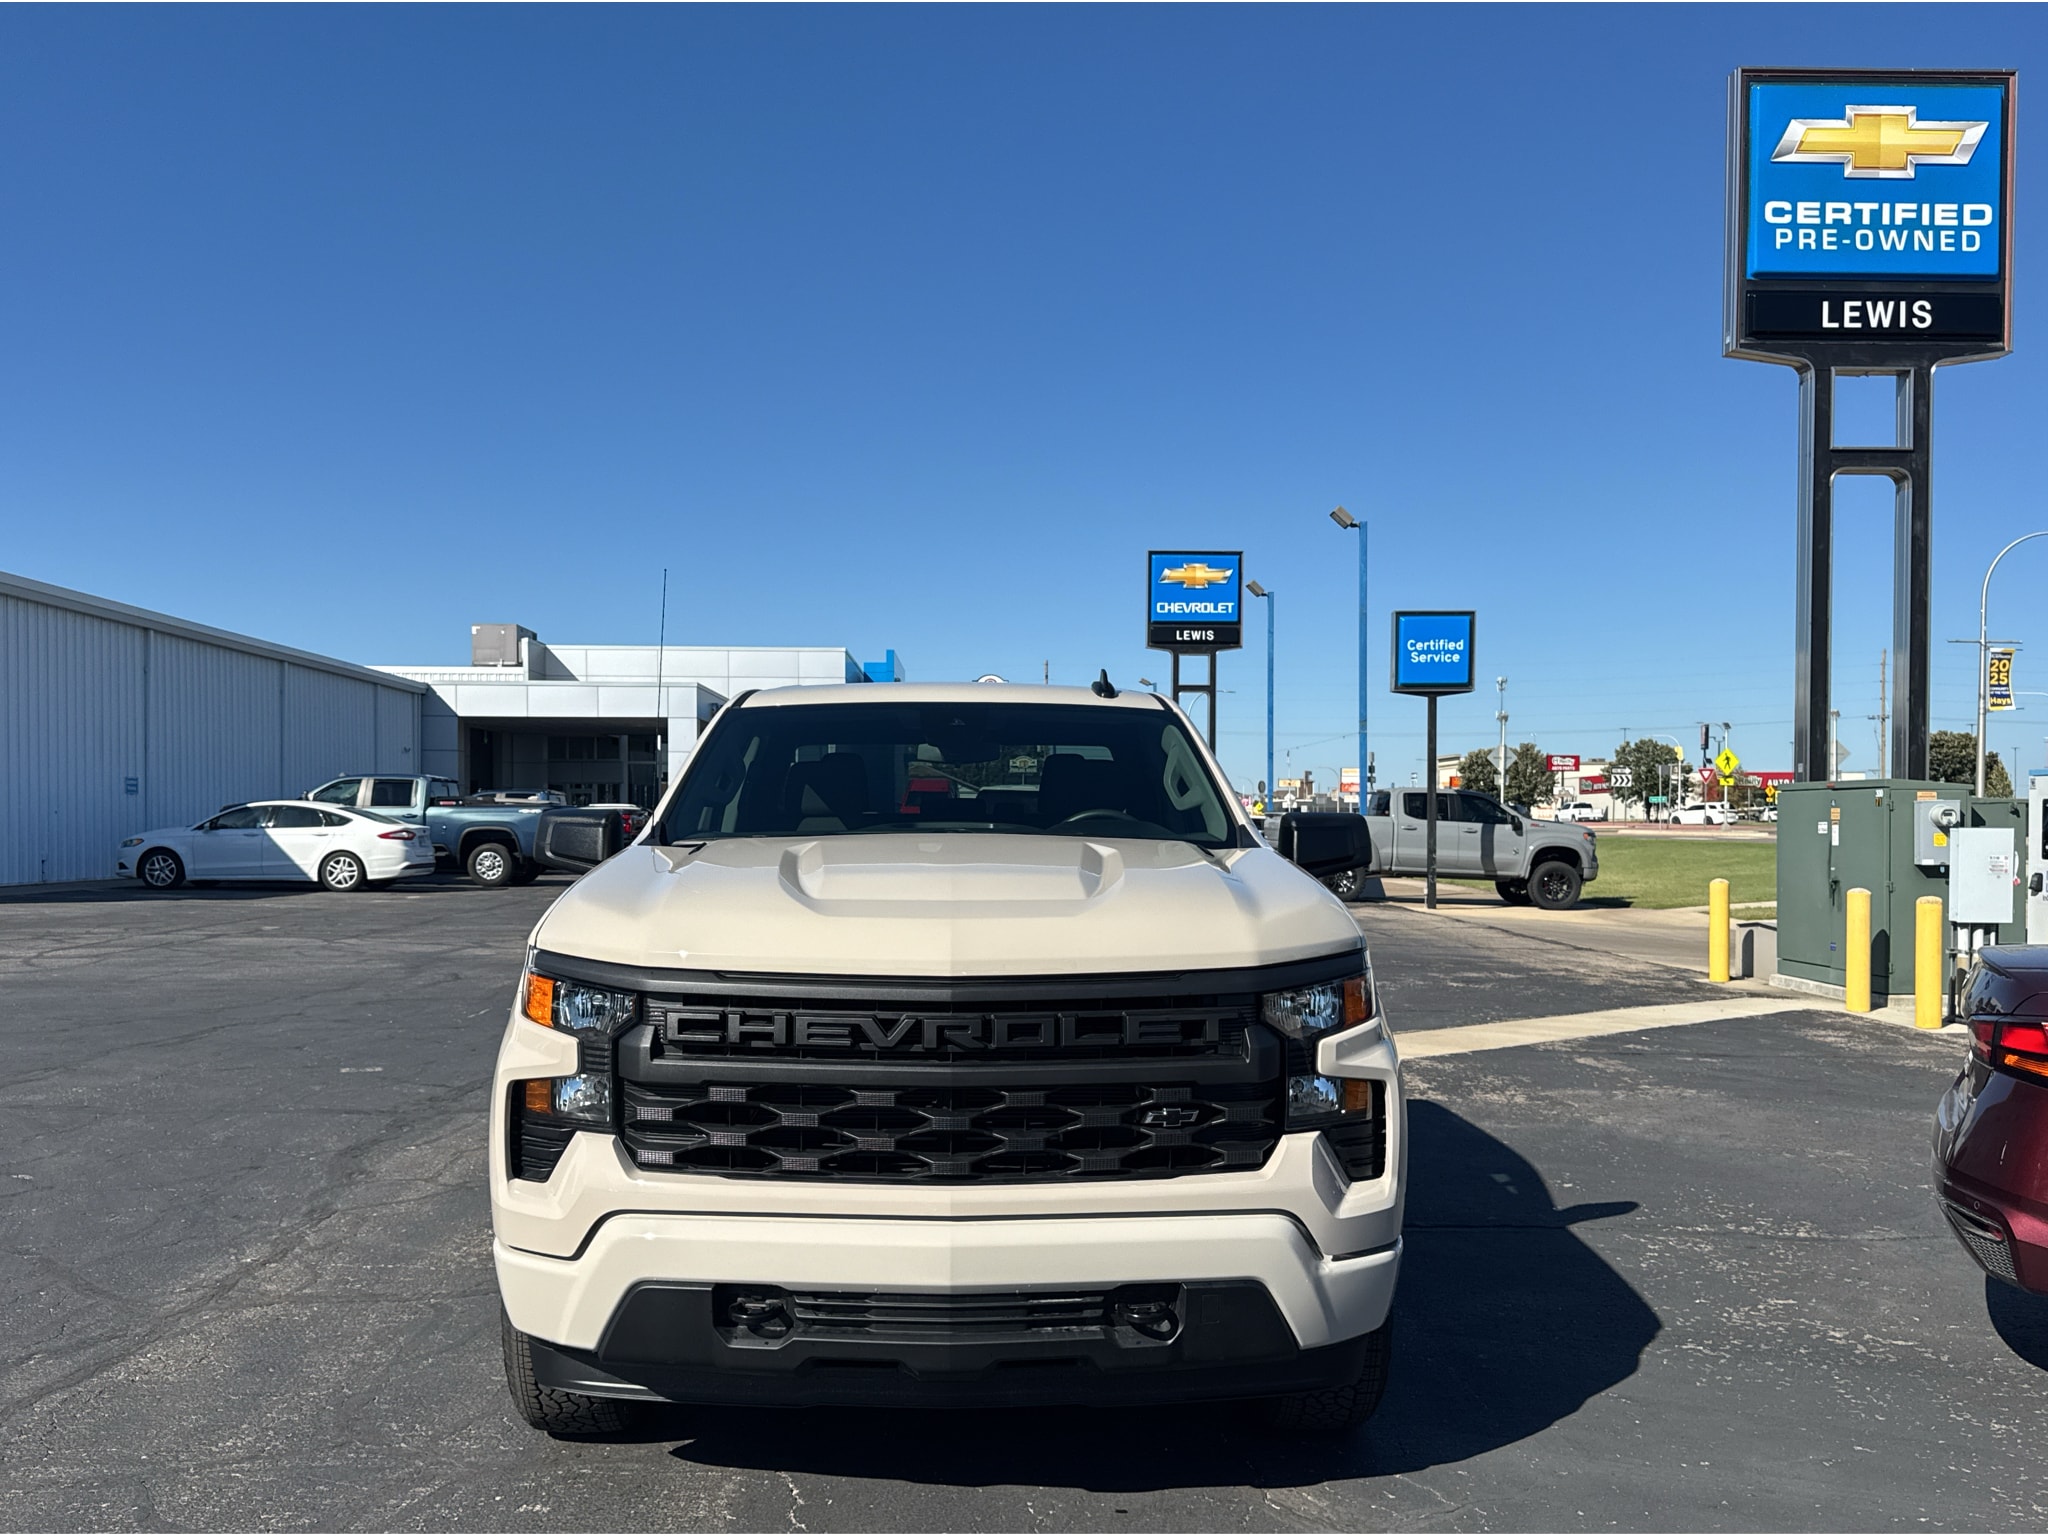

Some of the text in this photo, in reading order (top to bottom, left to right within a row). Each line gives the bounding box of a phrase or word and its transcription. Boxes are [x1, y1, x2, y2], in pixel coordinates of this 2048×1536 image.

[1764, 200, 1993, 226] CERTIFIED
[1775, 228, 1980, 252] PRE-OWNED
[1822, 300, 1932, 329] LEWIS
[1156, 602, 1234, 614] CHEVROLET
[1176, 630, 1214, 641] LEWIS
[1407, 639, 1464, 651] Certified
[1410, 651, 1460, 663] Service
[1990, 696, 2011, 705] Hays
[665, 1007, 1222, 1050] CHEVROLET
